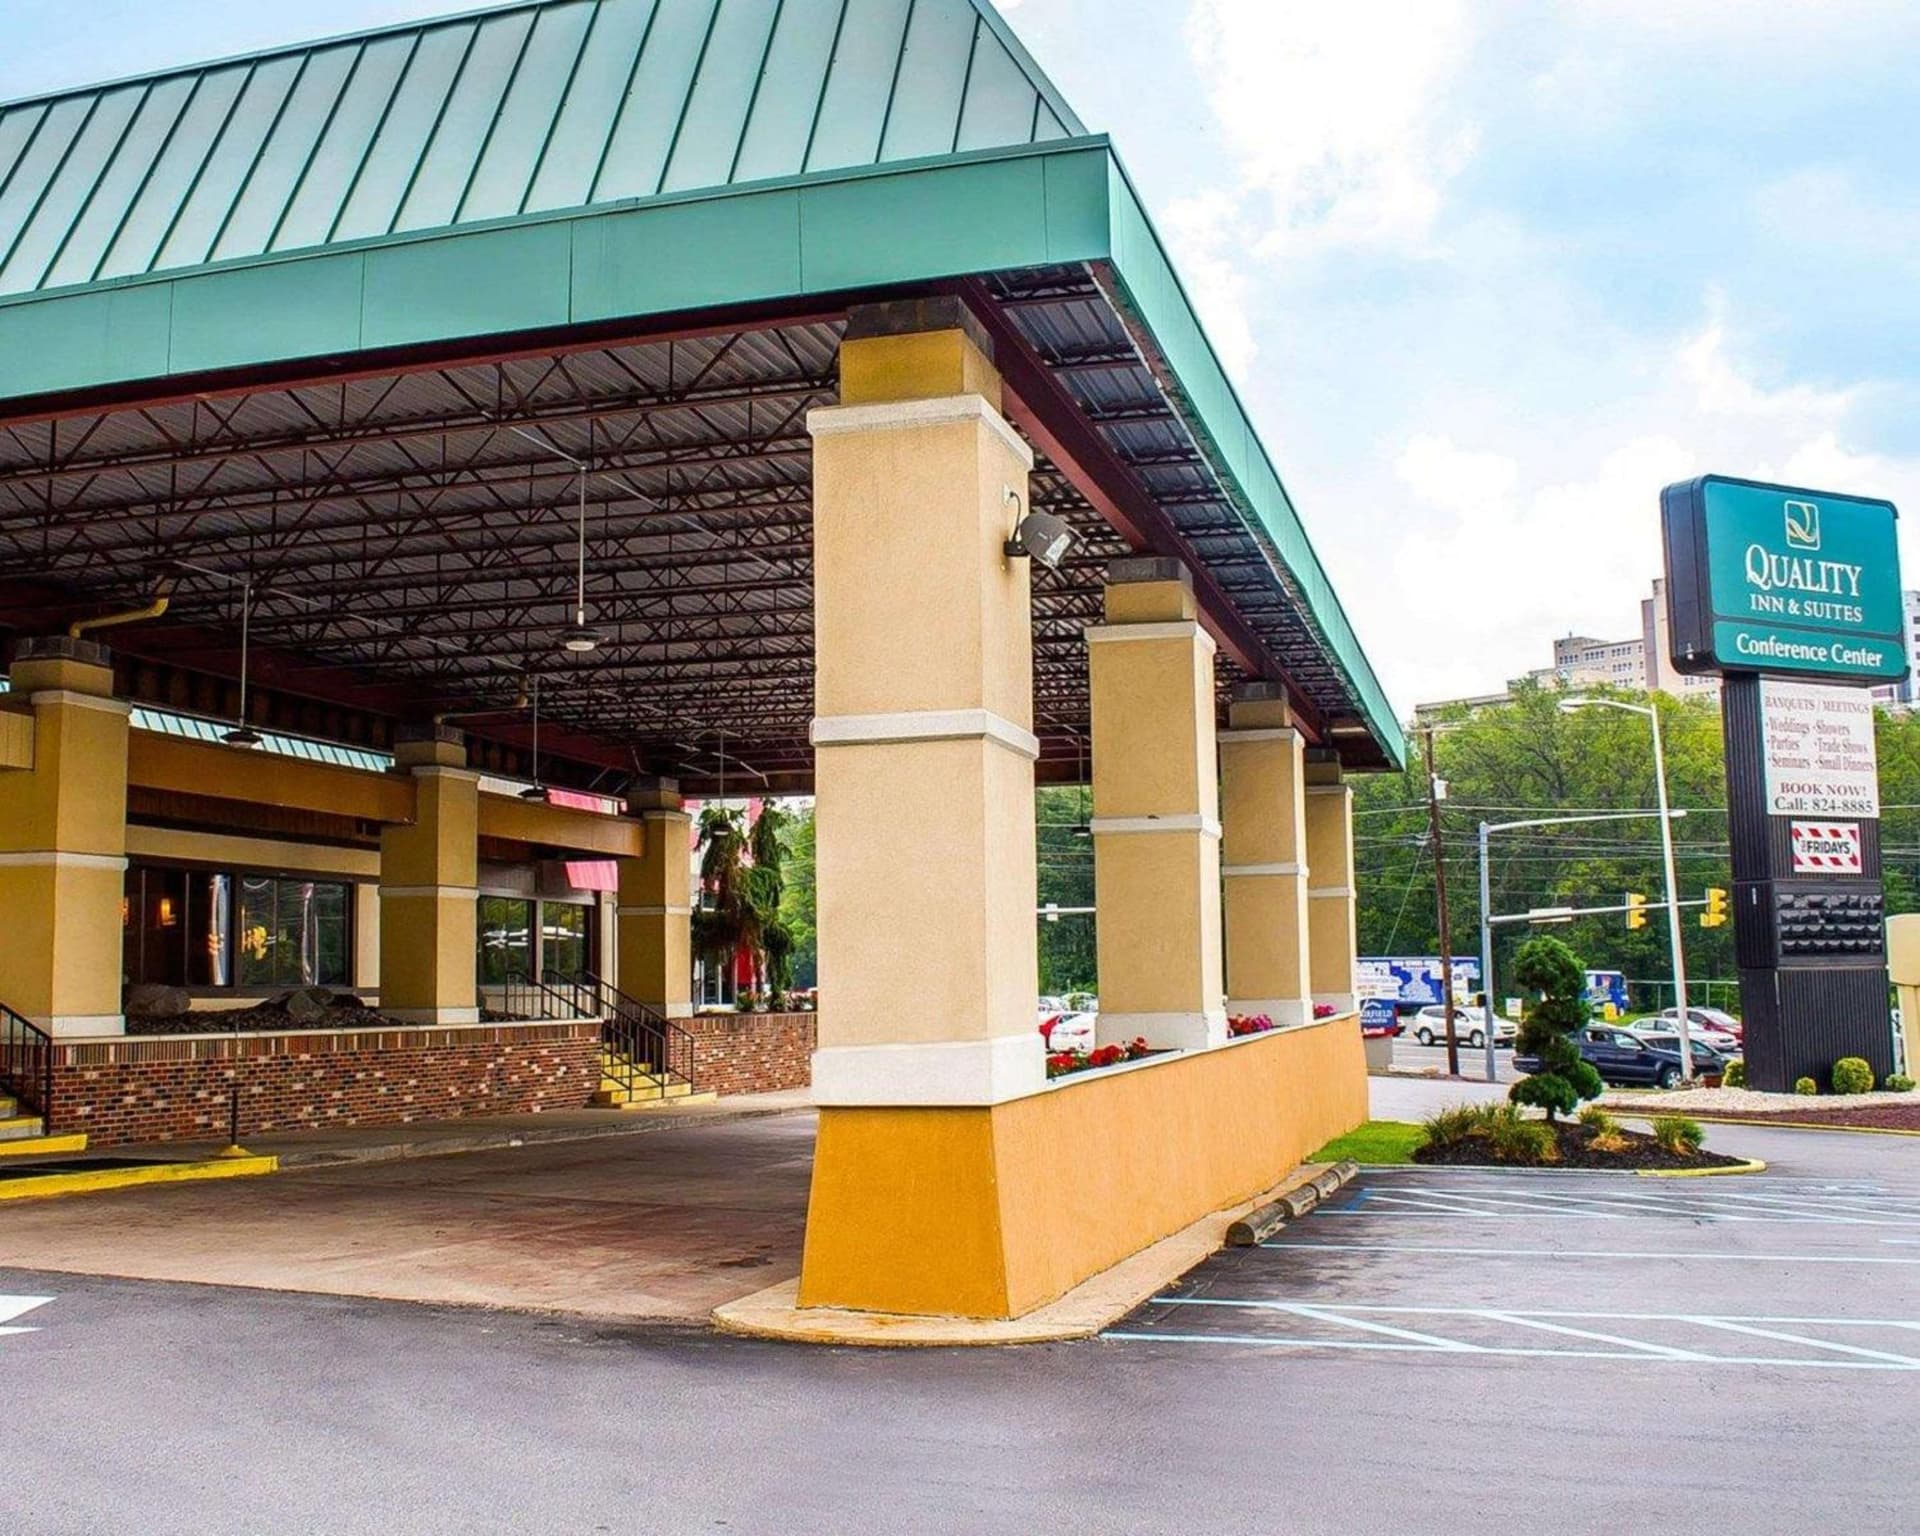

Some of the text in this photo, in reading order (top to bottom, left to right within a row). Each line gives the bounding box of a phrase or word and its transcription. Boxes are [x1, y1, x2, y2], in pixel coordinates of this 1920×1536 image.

[1745, 544, 1862, 597] QUALITY
[1750, 593, 1863, 623] INN & SUITES
[1736, 633, 1883, 667] Conference Center
[1823, 700, 1870, 714] MEETINGS
[1781, 782, 1867, 797] BOOK NOW!
[1775, 796, 1873, 813] Call: 824-8885
[1807, 840, 1851, 854] FRIDAYS
